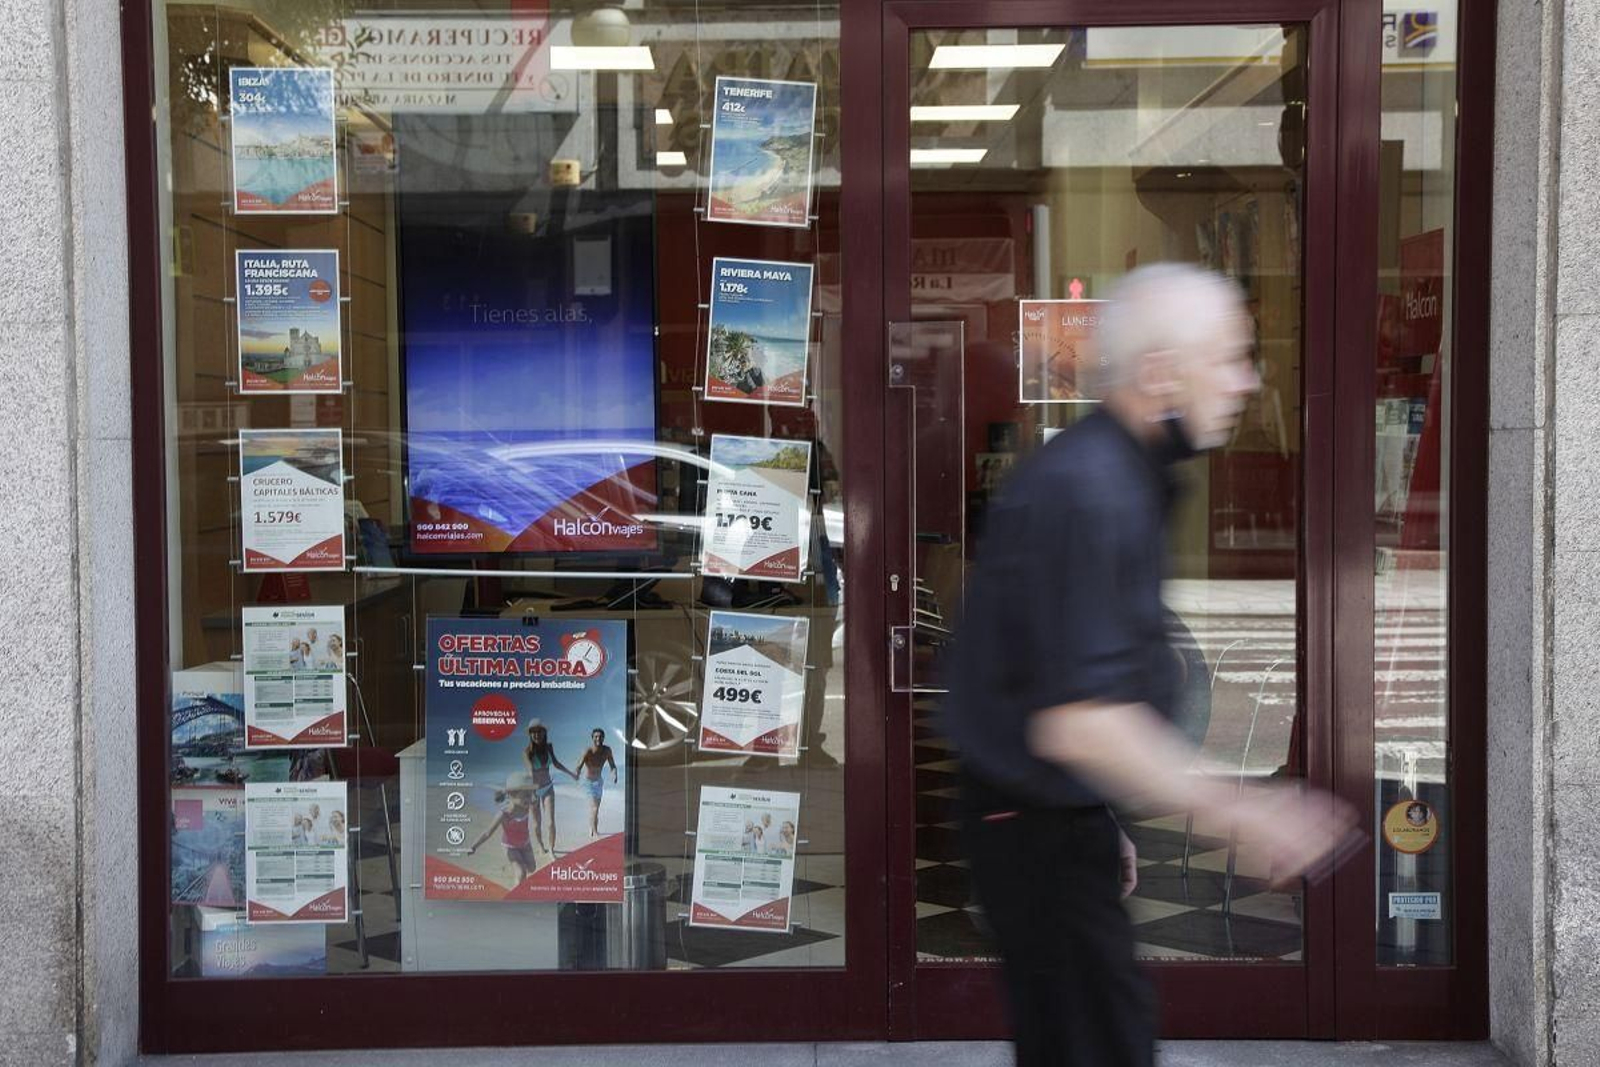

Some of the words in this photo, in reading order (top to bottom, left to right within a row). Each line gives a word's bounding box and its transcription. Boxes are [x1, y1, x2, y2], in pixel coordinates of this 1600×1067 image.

[238, 77, 268, 87] IBIZA
[723, 86, 773, 99] TENERIFE
[245, 259, 279, 271] ITALIA,
[283, 259, 309, 268] RUTA
[245, 269, 318, 278] FRANCISCANA
[720, 267, 761, 279] RIVIERA
[764, 270, 792, 281] MAYA
[469, 303, 539, 323] Tienes
[545, 302, 593, 325] alas,
[1062, 316, 1095, 326] LUNES
[253, 478, 292, 486] CRUCERO
[253, 488, 298, 497] CAPITALES
[254, 510, 302, 524] 1.579€
[438, 634, 541, 652] OFERTAS
[438, 654, 520, 676] ÚLTIMA
[525, 658, 587, 676] HORA
[439, 680, 454, 688] Tus
[456, 680, 502, 688] vacaciones
[510, 681, 540, 690] precios
[541, 680, 585, 689] imbatibles
[713, 686, 762, 704] 499€
[473, 717, 505, 725] RESERVA
[215, 938, 257, 952] Grandes
